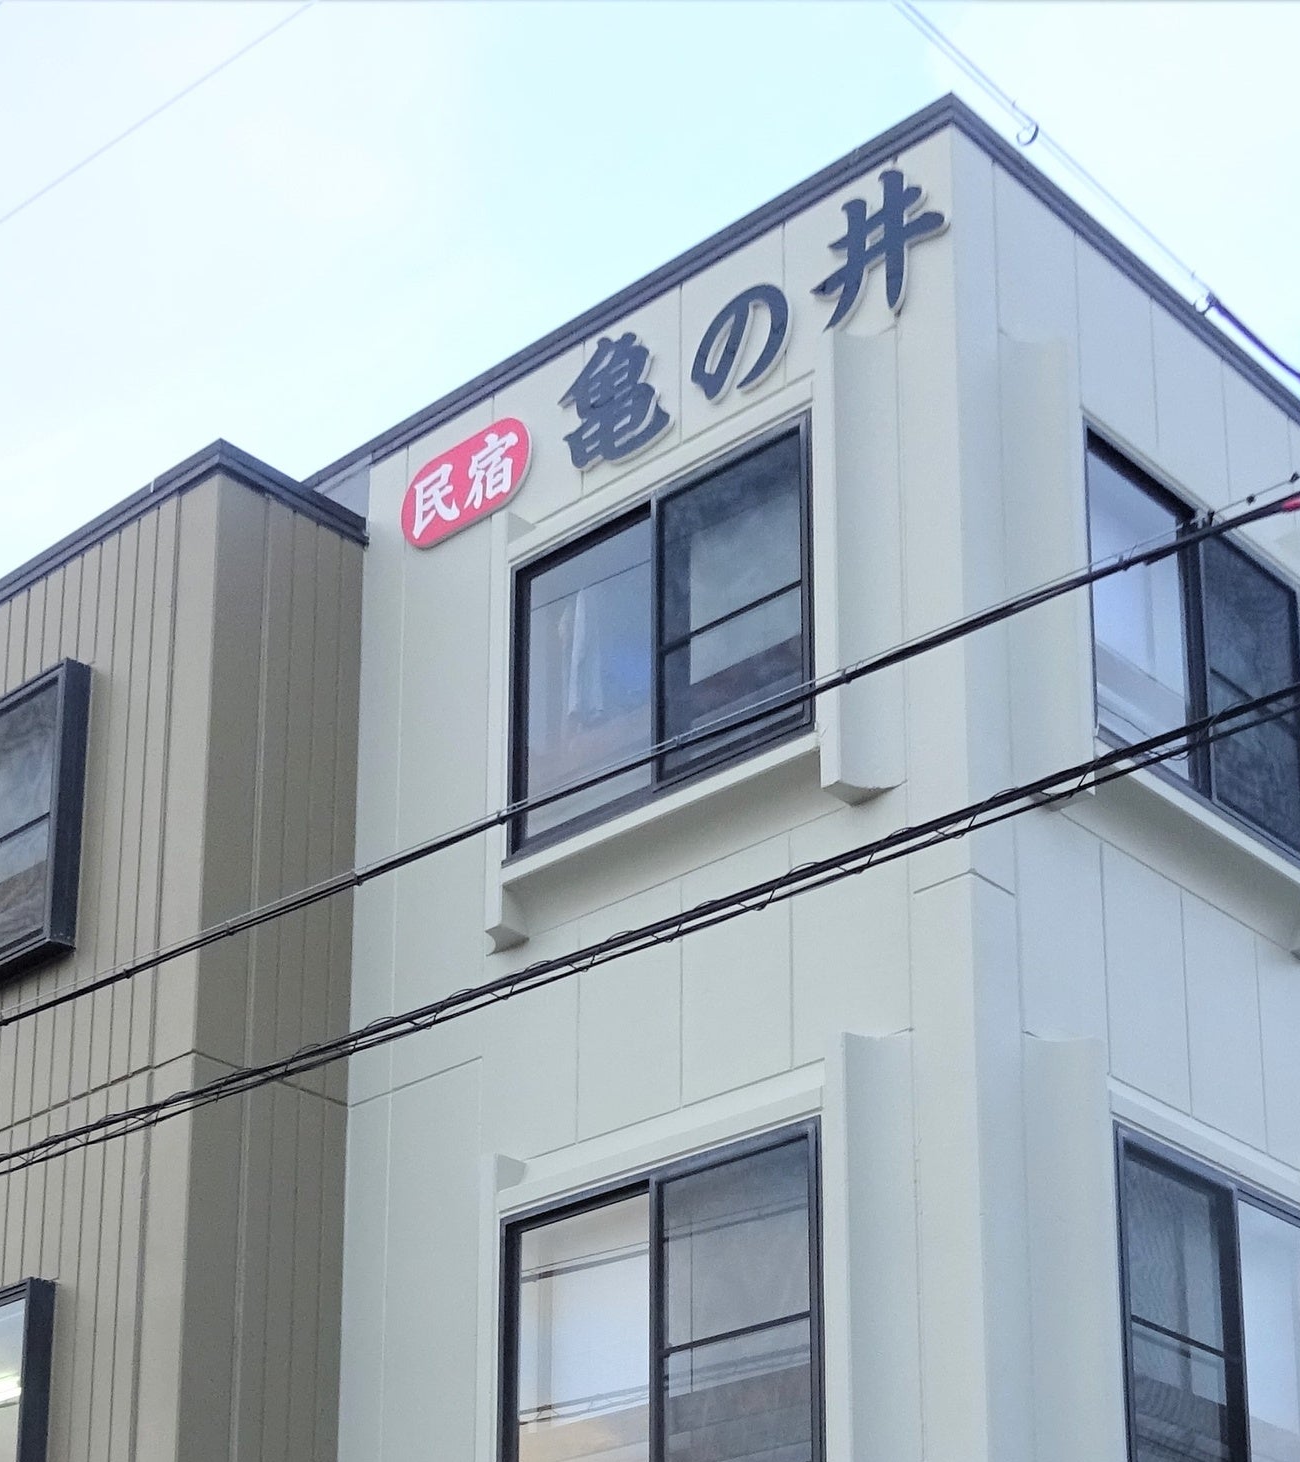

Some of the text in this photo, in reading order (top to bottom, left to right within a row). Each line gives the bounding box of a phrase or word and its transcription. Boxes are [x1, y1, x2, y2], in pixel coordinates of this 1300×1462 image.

[412, 168, 946, 540] 民宿 亀の井
